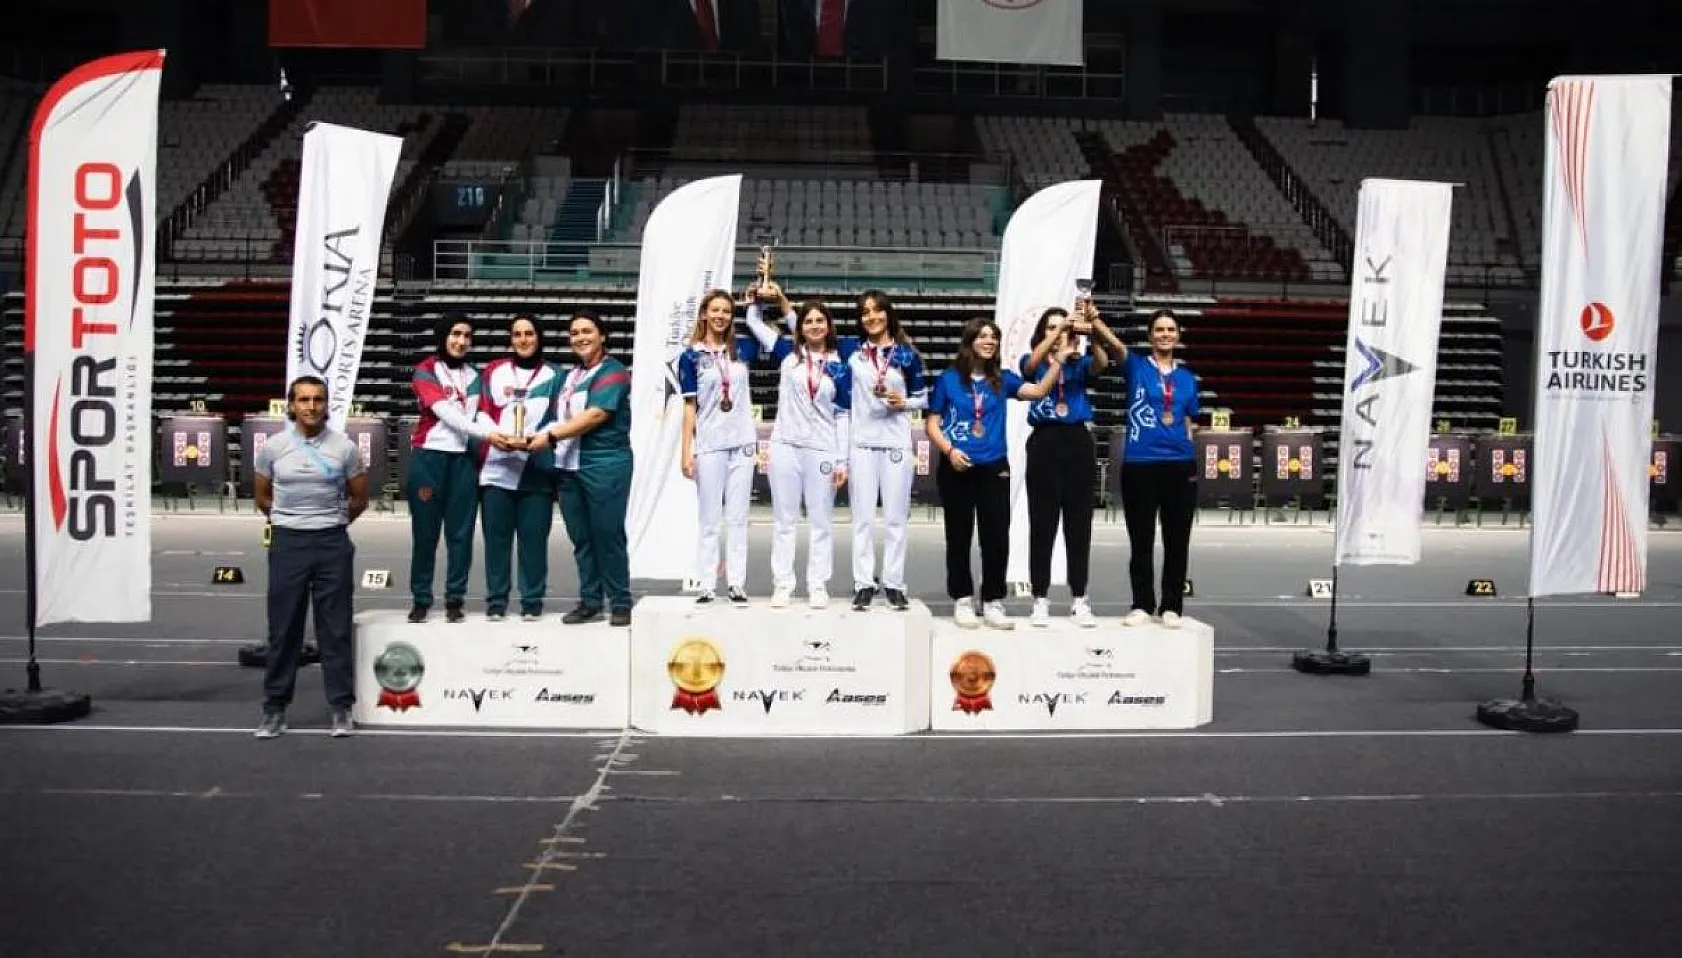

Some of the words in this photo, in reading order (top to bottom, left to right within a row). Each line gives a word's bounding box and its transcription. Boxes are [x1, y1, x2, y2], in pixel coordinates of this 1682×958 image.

[1351, 255, 1424, 470] NAVEK
[1547, 350, 1647, 371] TURKISH
[1546, 372, 1647, 392] AIRLINES
[217, 569, 235, 581] 14
[366, 573, 384, 585] 15
[1313, 582, 1332, 593] 21
[1474, 581, 1493, 593] 22
[443, 688, 513, 712] NAVEK
[733, 689, 804, 714] NAVEK
[1017, 693, 1086, 717] NAVEK
